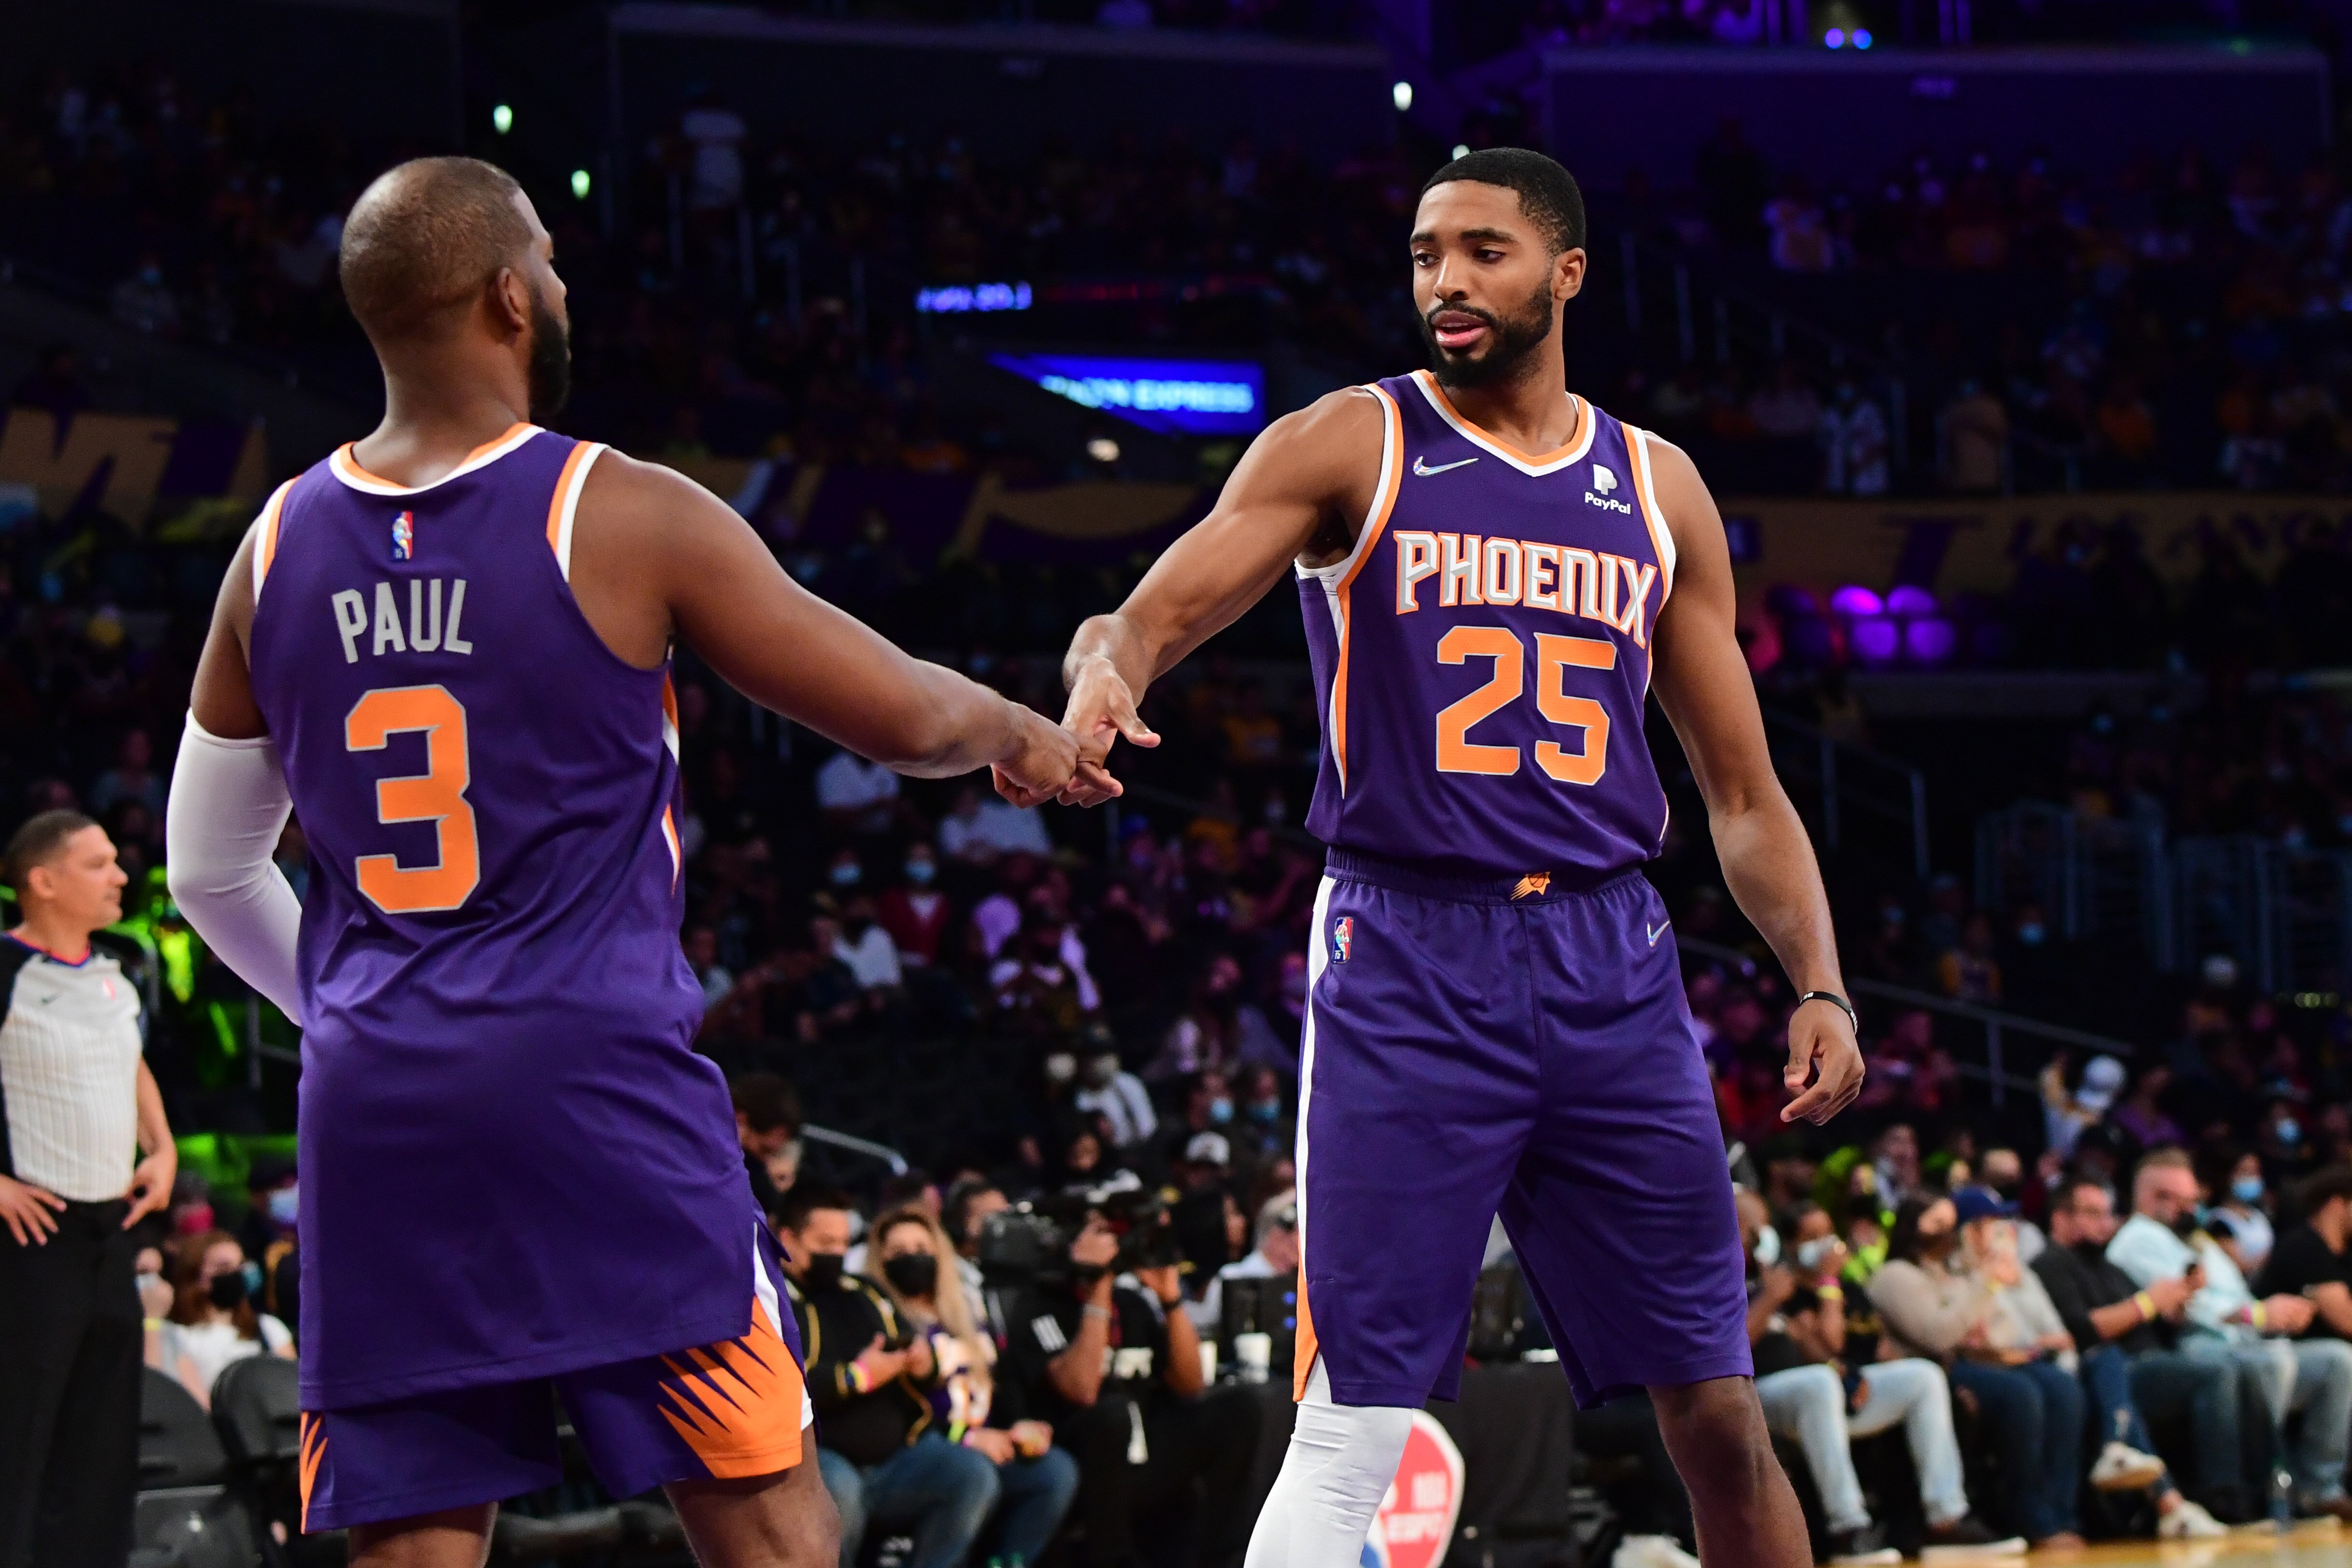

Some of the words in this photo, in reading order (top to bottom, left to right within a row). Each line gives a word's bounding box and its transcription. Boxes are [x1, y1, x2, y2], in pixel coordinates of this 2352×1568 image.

[1585, 491, 1631, 514] PayPal
[332, 579, 473, 664] PAUL
[1393, 530, 1656, 649] PHOENIX
[1436, 625, 1617, 786] 25
[345, 684, 480, 914] 3
